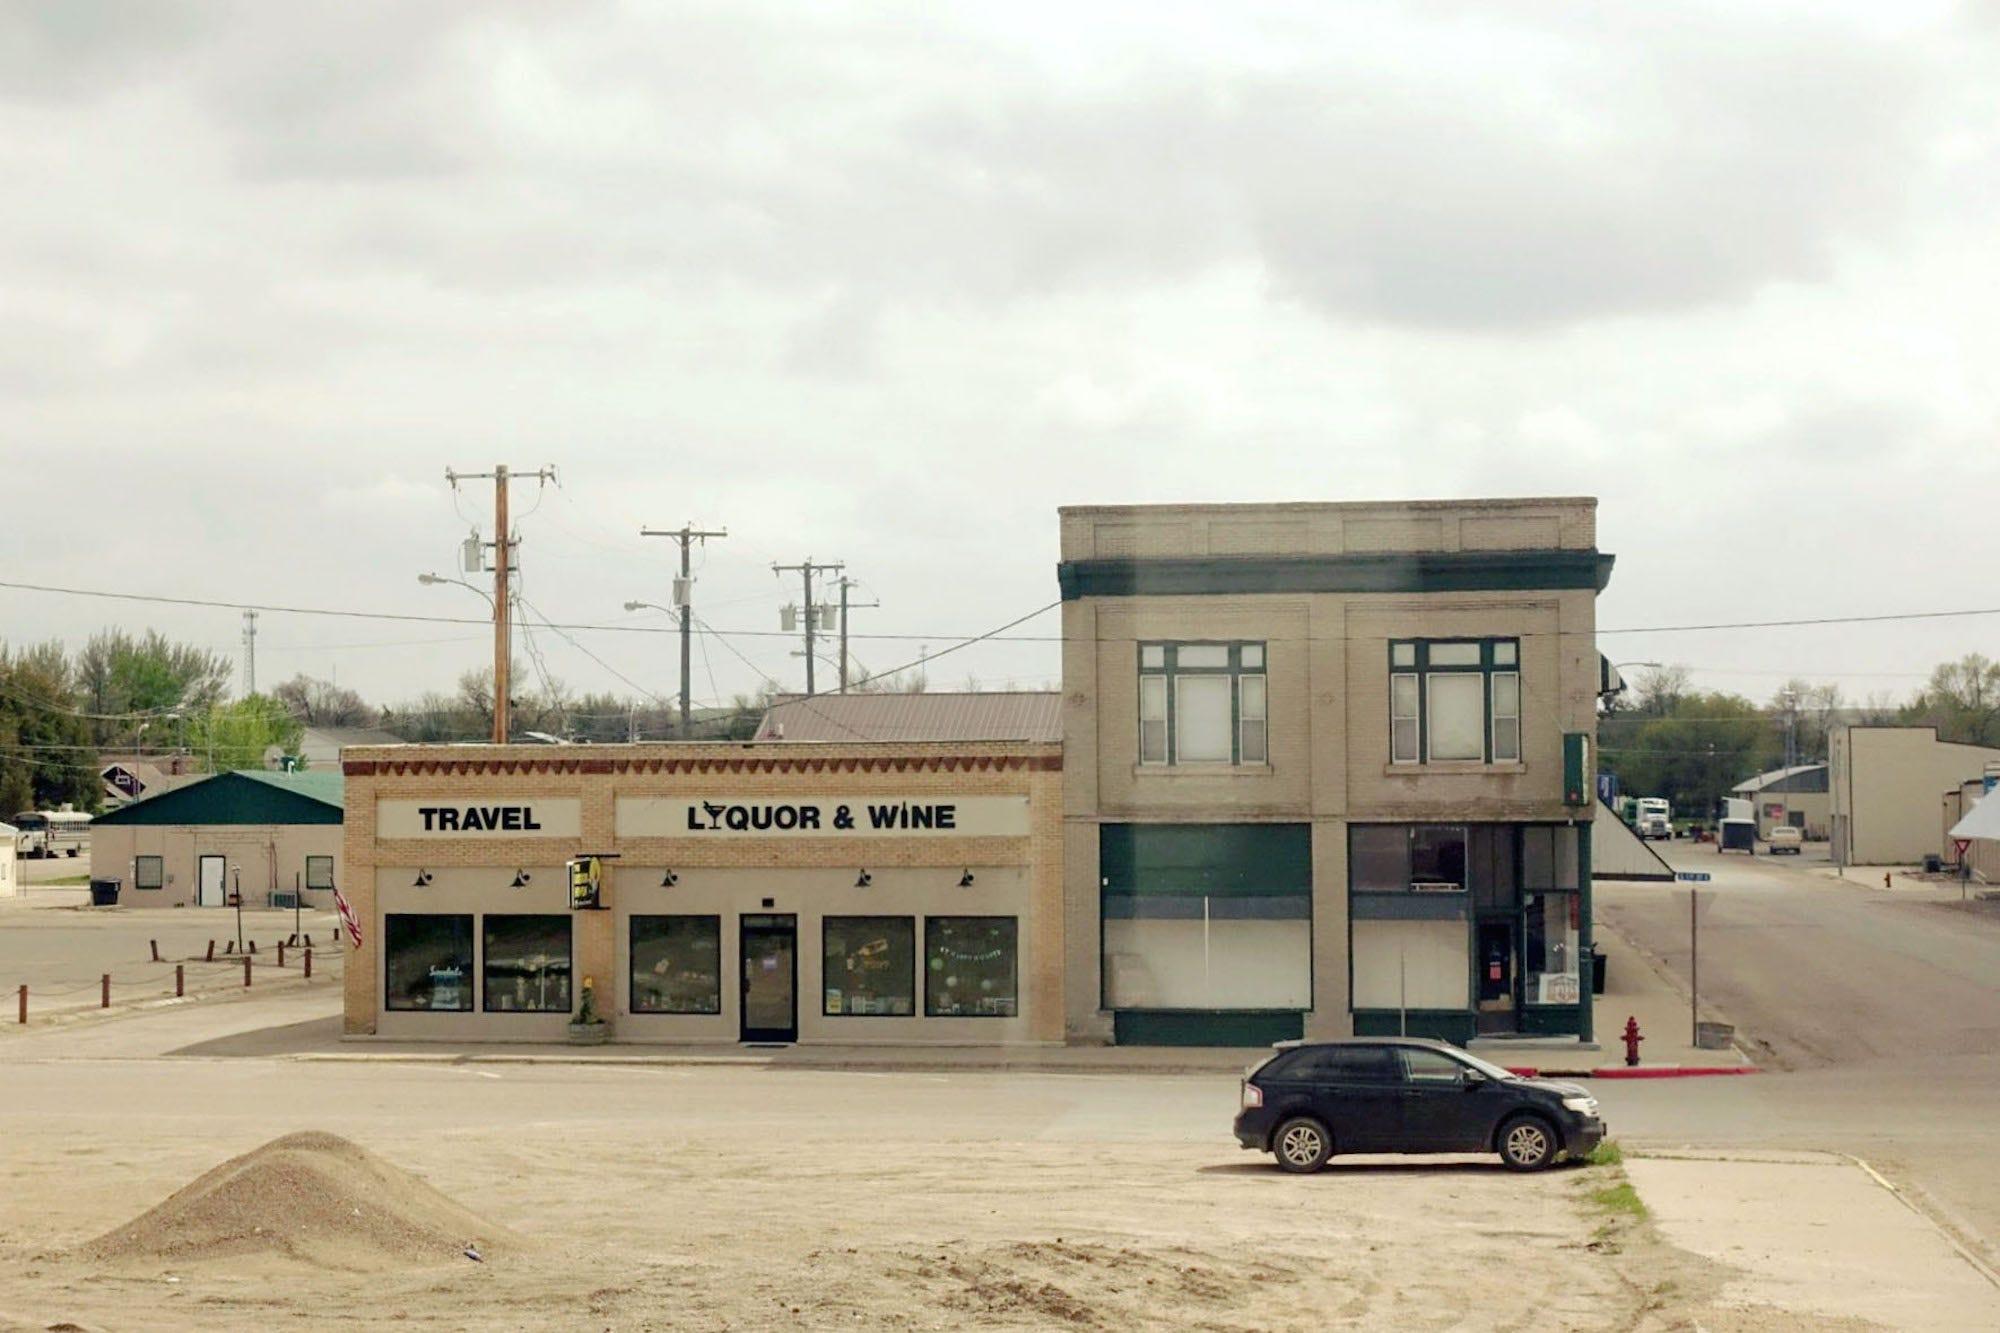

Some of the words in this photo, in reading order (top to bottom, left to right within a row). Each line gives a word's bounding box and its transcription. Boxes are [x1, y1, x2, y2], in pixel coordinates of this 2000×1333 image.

[418, 807, 541, 831] TRAVEL
[833, 805, 855, 829] &
[868, 802, 956, 829] WINE
